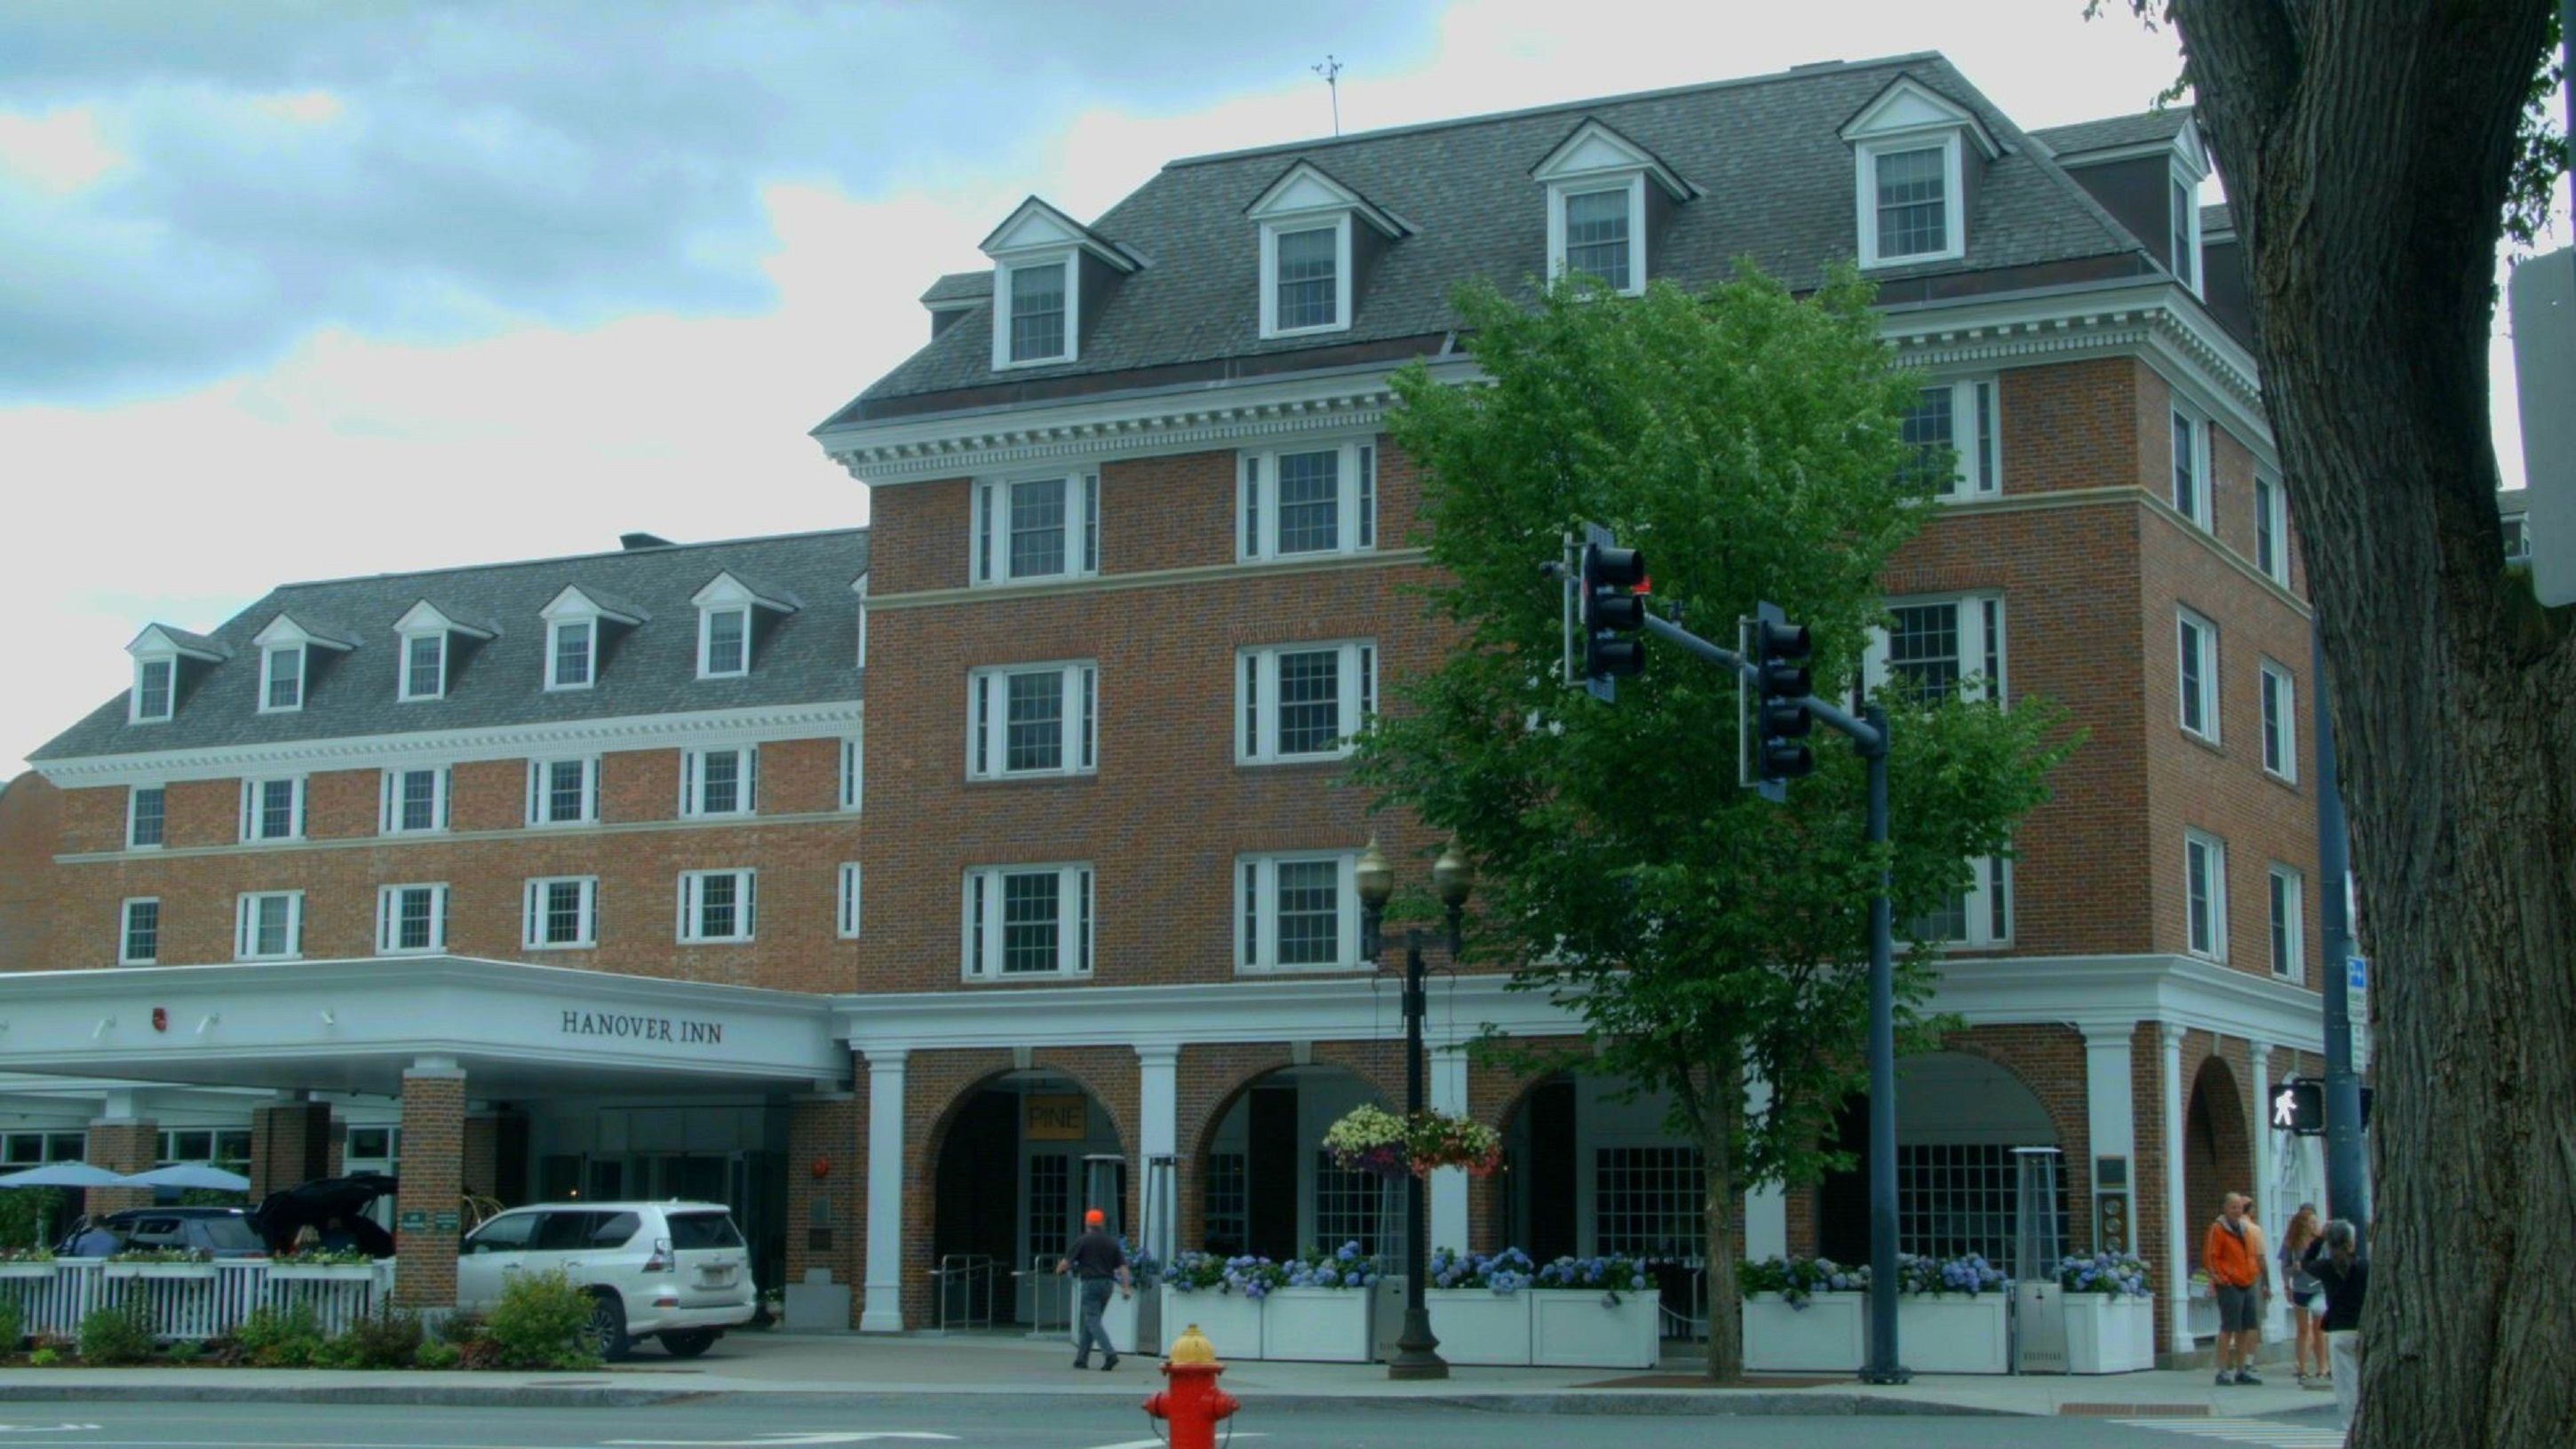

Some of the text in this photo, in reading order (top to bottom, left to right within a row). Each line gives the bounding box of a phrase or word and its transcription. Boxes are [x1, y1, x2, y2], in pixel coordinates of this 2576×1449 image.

[561, 1010, 722, 1044] HANOVER INN
[1029, 1105, 1081, 1128] PINE
